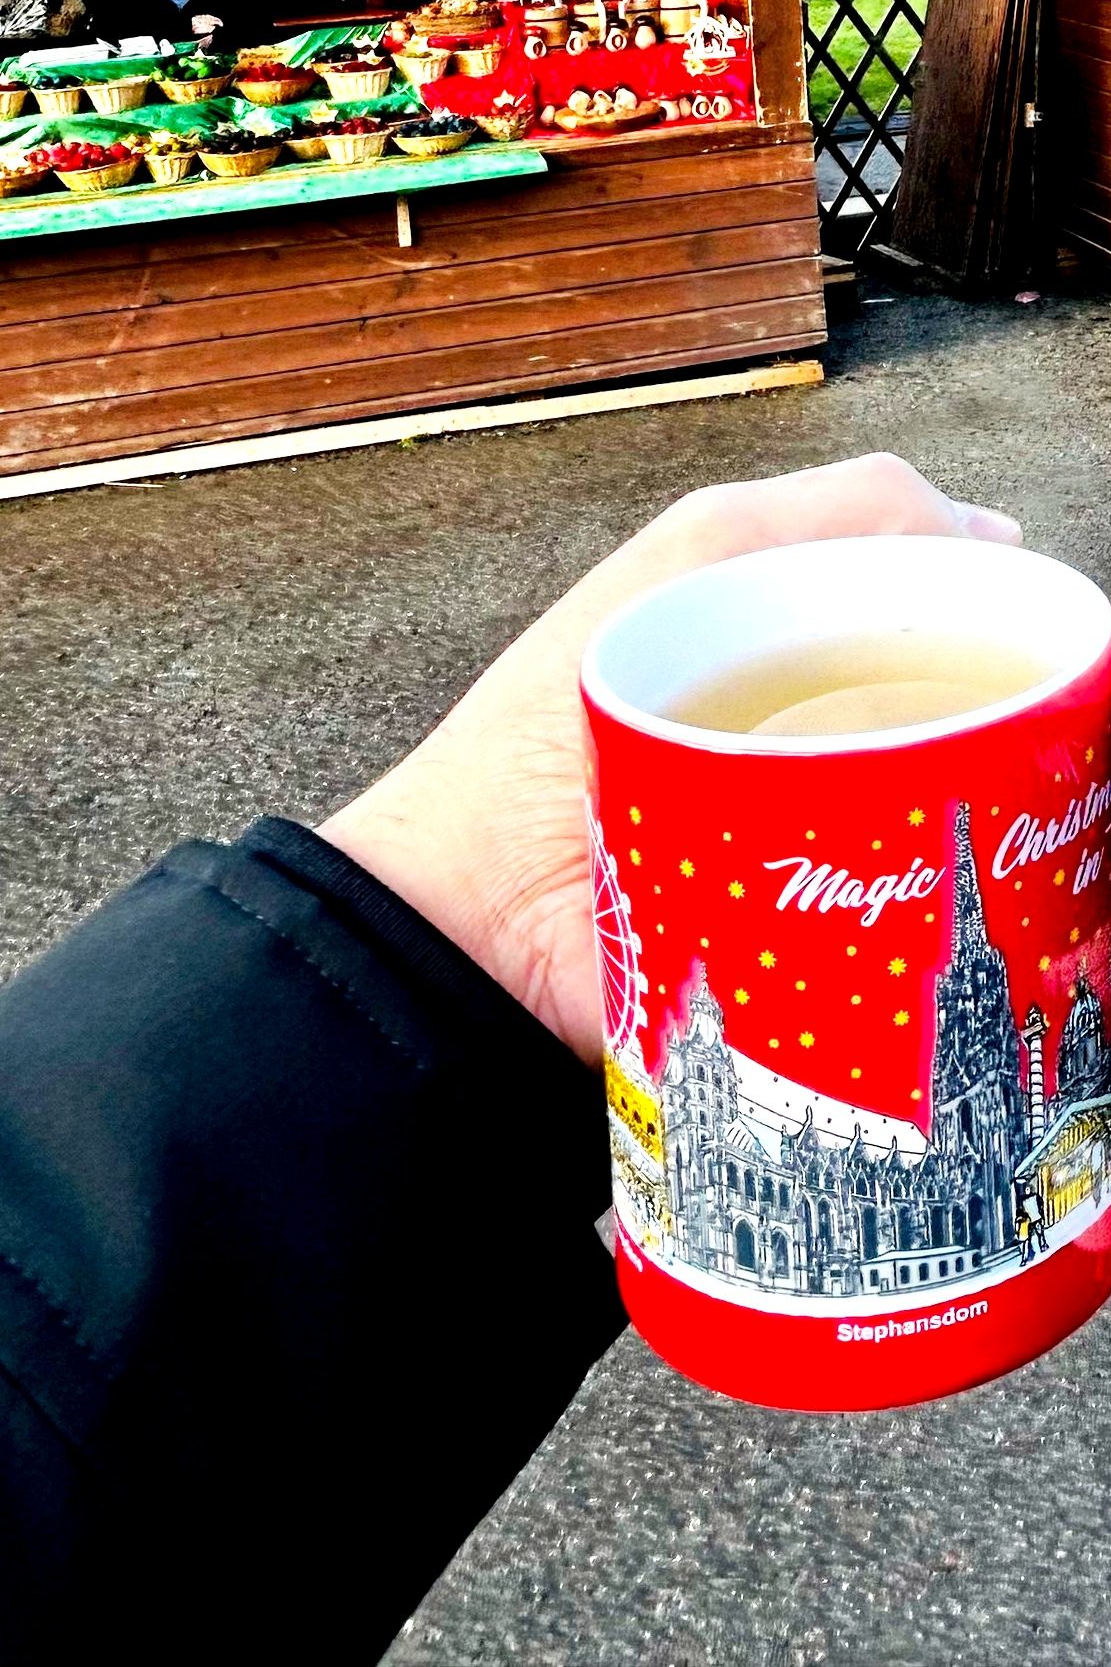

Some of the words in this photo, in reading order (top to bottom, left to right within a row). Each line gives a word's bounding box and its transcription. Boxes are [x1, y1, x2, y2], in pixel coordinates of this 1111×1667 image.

[763, 856, 947, 927] Magic
[1073, 847, 1104, 895] in
[837, 1300, 988, 1343] Stephansdom
